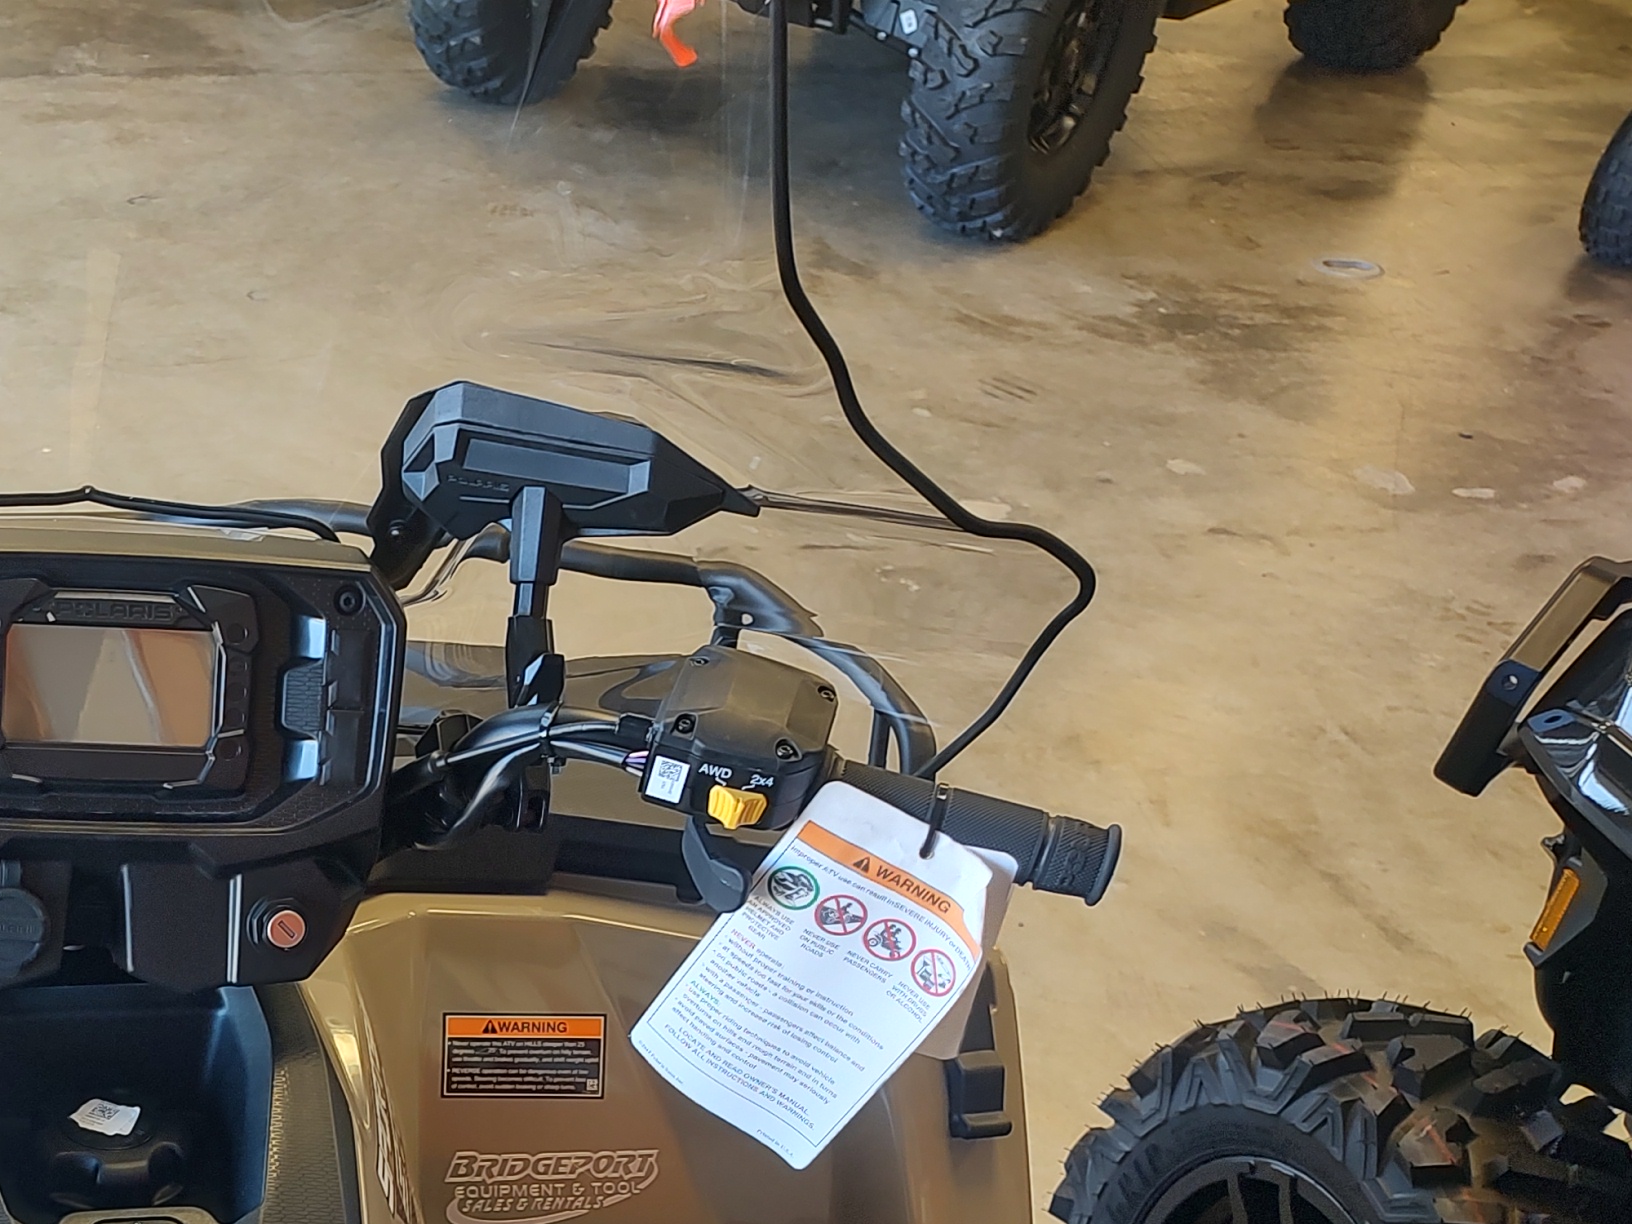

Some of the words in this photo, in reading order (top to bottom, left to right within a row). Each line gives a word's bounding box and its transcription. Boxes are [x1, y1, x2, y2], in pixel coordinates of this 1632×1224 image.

[698, 763, 733, 779] AWD
[750, 774, 774, 787] 2x4
[876, 865, 952, 914] WARNING
[497, 1021, 568, 1034] WARNING
[444, 1149, 659, 1184] BRIDGEPORT
[454, 1183, 565, 1199] EQUIPMENT
[572, 1182, 585, 1196] &
[590, 1181, 640, 1195] TOOL
[462, 1198, 513, 1212] SALES
[530, 1195, 604, 1211] RENTALS
